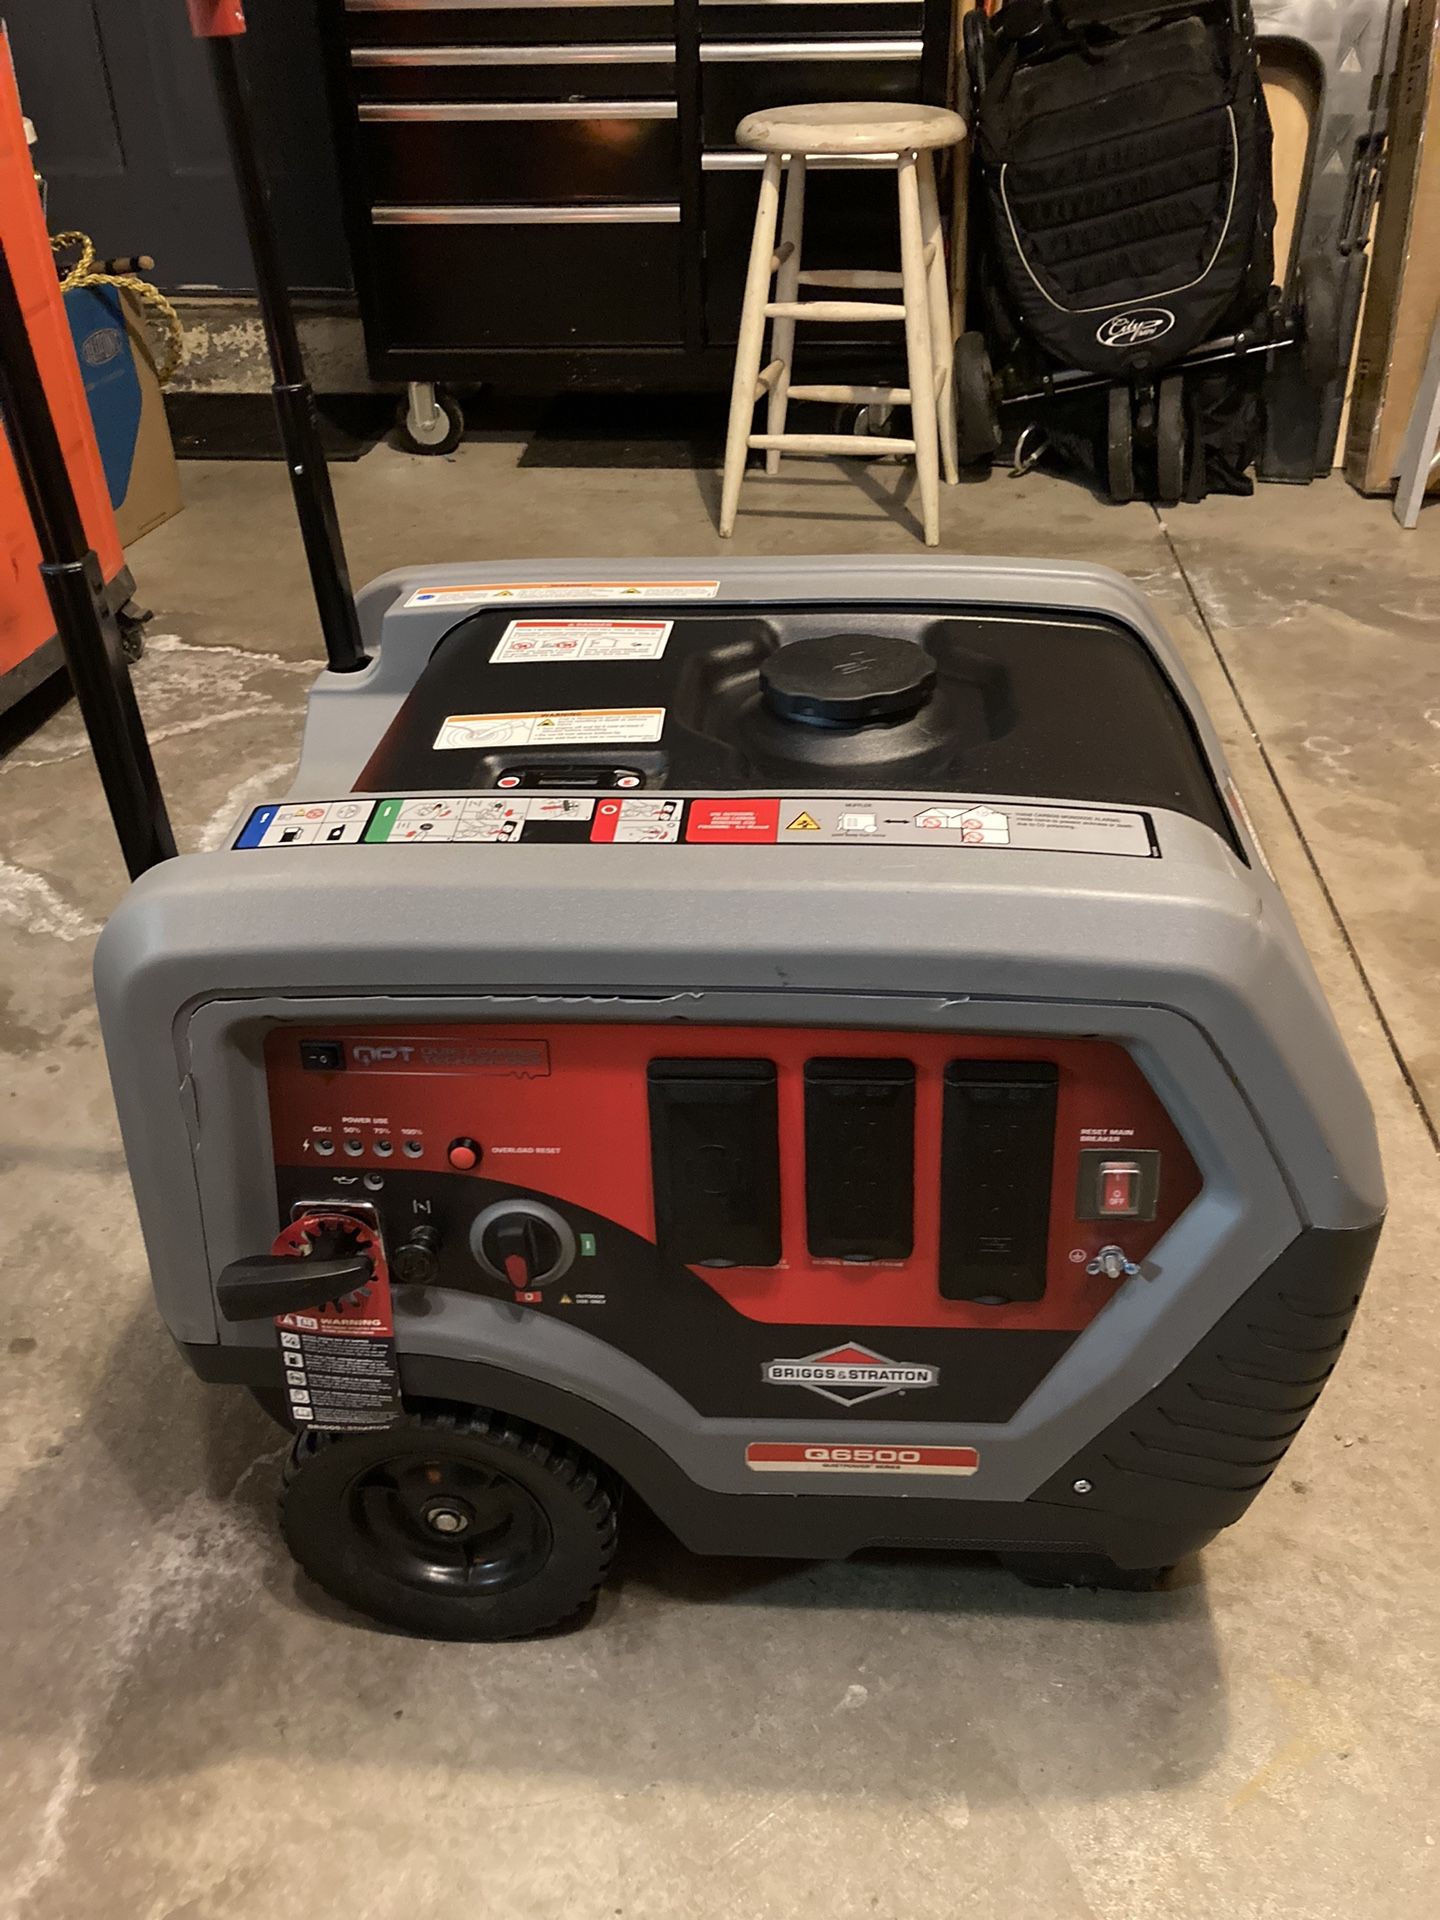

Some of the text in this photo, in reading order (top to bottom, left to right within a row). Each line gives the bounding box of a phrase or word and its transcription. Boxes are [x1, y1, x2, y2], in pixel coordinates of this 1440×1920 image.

[1105, 317, 1163, 343] City
[343, 1126, 361, 1134] 50%
[373, 1127, 391, 1135] 75%
[1108, 1198, 1124, 1206] OFF
[320, 1318, 382, 1327] WARNING
[804, 1447, 920, 1463] Q6500
